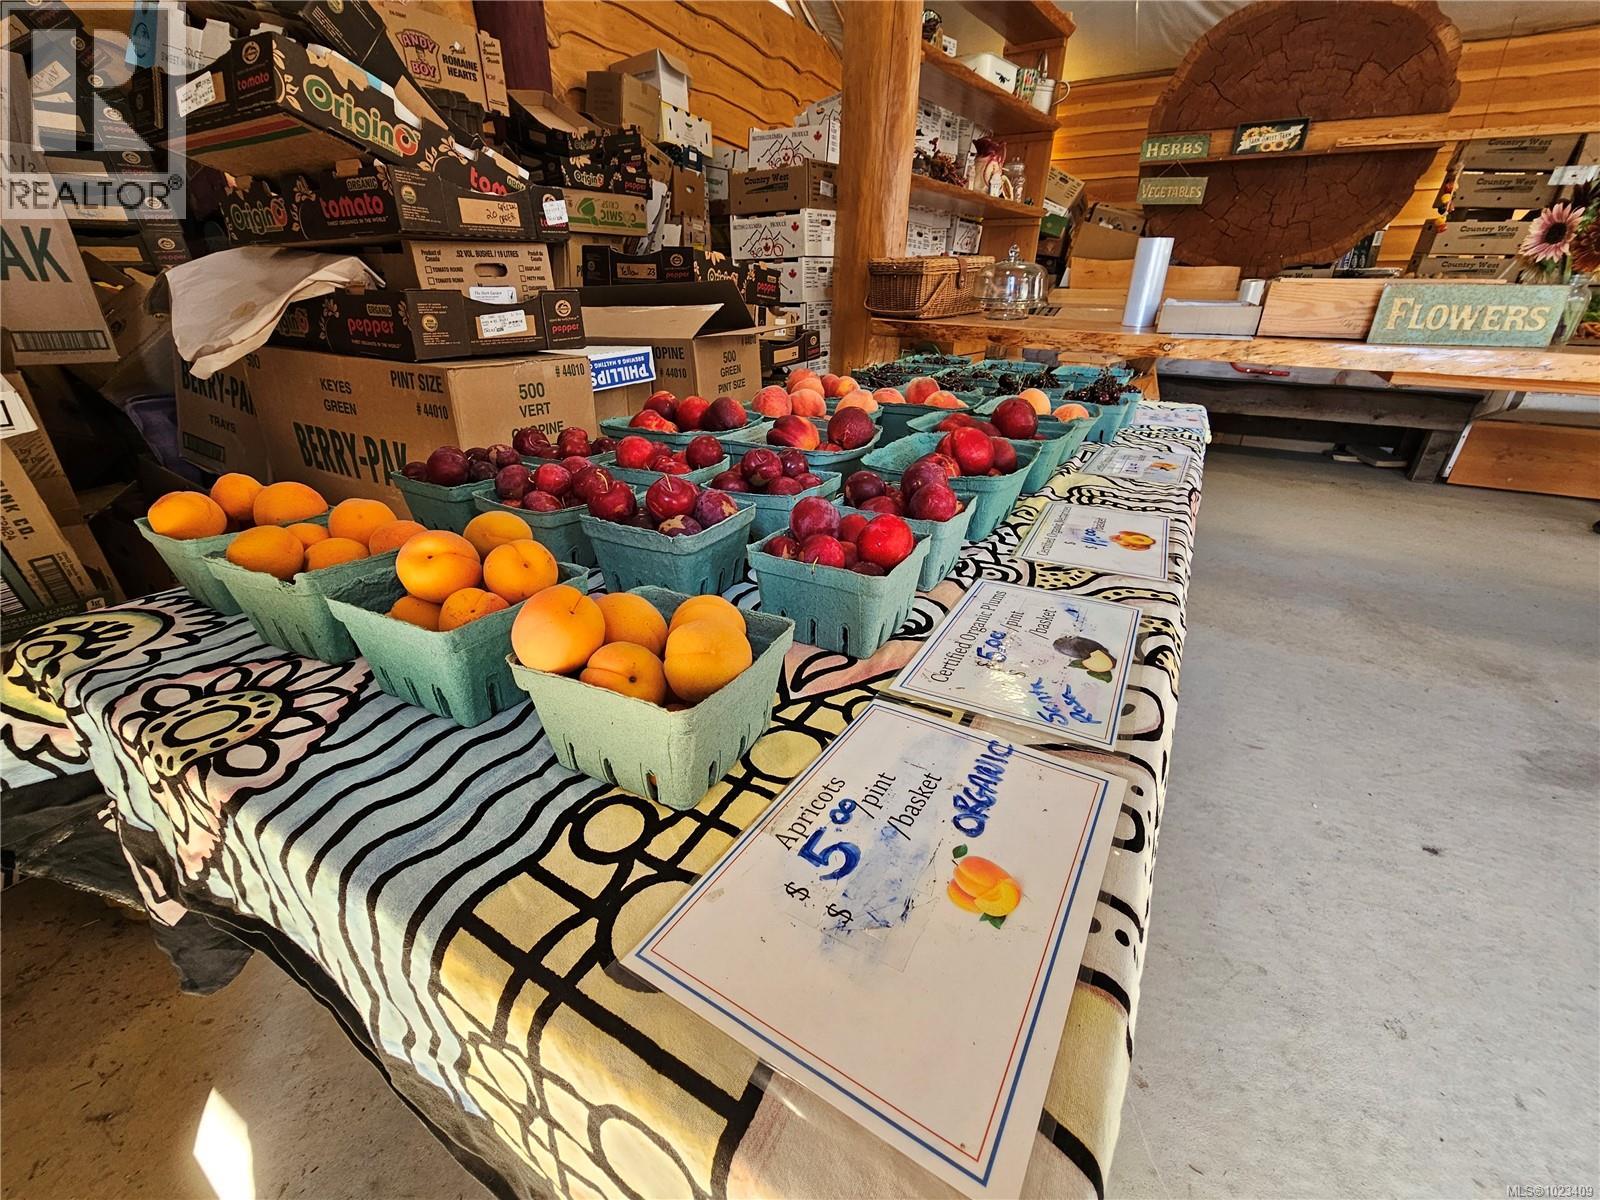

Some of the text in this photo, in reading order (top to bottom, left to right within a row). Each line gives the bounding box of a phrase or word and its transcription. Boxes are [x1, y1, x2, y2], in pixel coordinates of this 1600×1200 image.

[401, 30, 439, 54] ANDY
[411, 60, 437, 78] BOY
[442, 54, 479, 72] ROMAINE
[237, 71, 270, 91] tomato
[447, 66, 478, 82] HEARTS
[1146, 141, 1202, 158] HERBS
[1487, 138, 1553, 147] Country West
[346, 176, 378, 191] ORGANIC
[744, 175, 770, 186] Country
[772, 173, 789, 181] West
[1476, 178, 1537, 187] Country West
[1142, 184, 1202, 199] VEGETABLES
[320, 193, 384, 219] tomato
[486, 208, 497, 219] 20
[1459, 225, 1495, 234] Country
[620, 265, 639, 276] Yellow
[1441, 261, 1477, 269] Country
[1385, 297, 1550, 332] FLOWERS
[347, 318, 394, 338] pepper
[551, 323, 579, 334] pepper
[652, 346, 685, 360] OPINE
[723, 350, 737, 363] 500
[555, 363, 585, 377] # 44010
[594, 359, 617, 369] MALTING
[720, 363, 741, 377] GREEN
[591, 363, 649, 388] PHILLIPS
[665, 368, 687, 378] 44010
[320, 378, 352, 394] KEYES
[390, 370, 444, 394] PINT SIZE
[718, 378, 746, 394] PINT SIZE
[519, 382, 545, 400] 500
[323, 399, 357, 415] GREEN
[416, 402, 449, 420] # 44010
[519, 402, 550, 418] VERT
[209, 414, 237, 433] TRAYS
[13, 517, 35, 540] CO.
[1000, 609, 1026, 632] /pint
[1027, 607, 1058, 639] /basket
[930, 590, 1007, 683] Certified Organic Plums
[952, 740, 1015, 838] ORGANIC
[775, 776, 845, 851] Apricots
[784, 881, 811, 901] $
[854, 771, 897, 819] /pint
[826, 772, 942, 924] $ /basket
